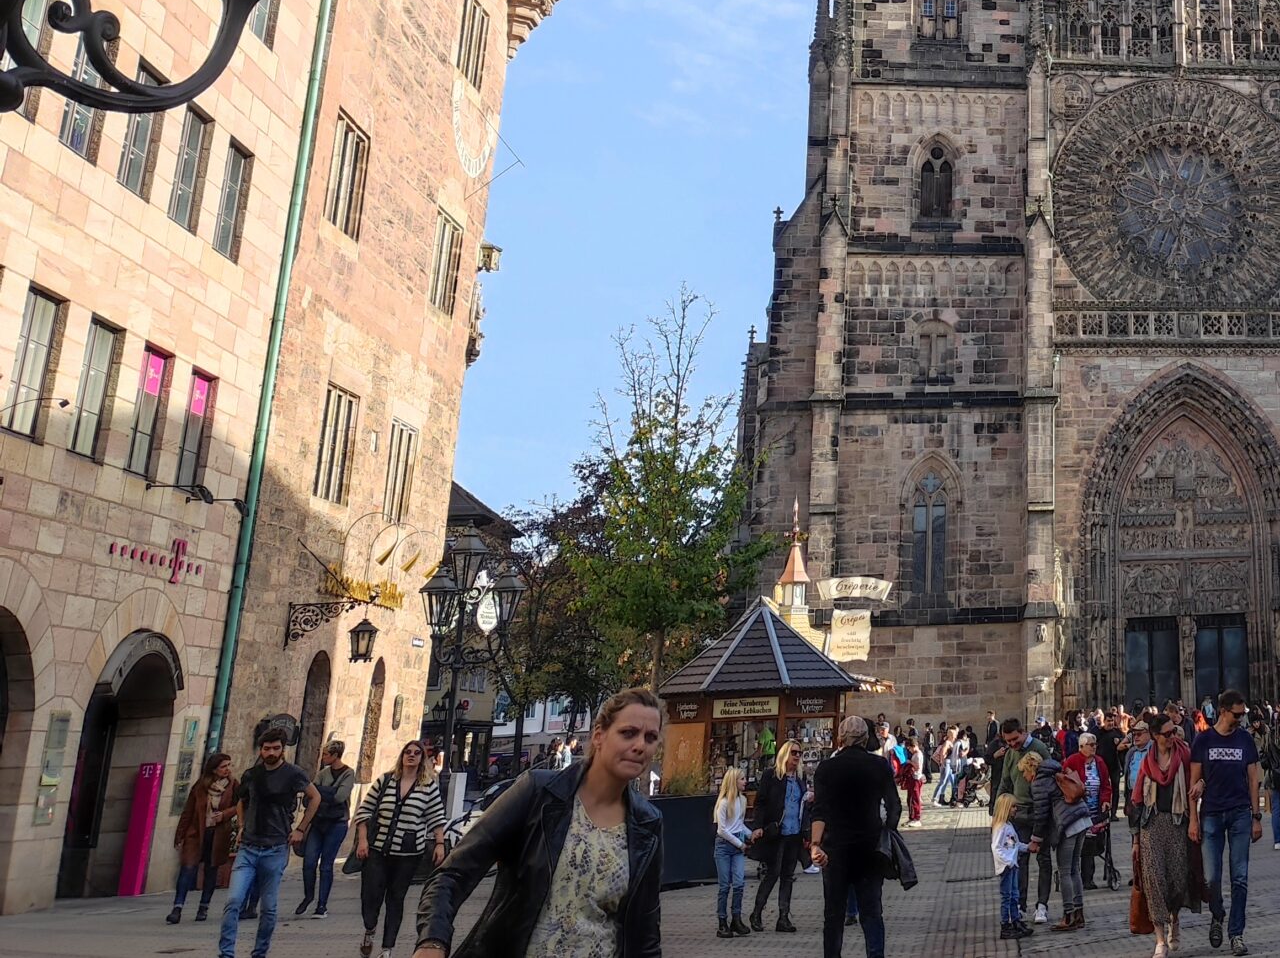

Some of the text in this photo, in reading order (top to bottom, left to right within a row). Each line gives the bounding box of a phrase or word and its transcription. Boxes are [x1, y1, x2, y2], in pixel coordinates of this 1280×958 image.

[723, 699, 770, 708] Feine Nürnberger
[720, 707, 772, 716] Oblaten-Lebkuchen
